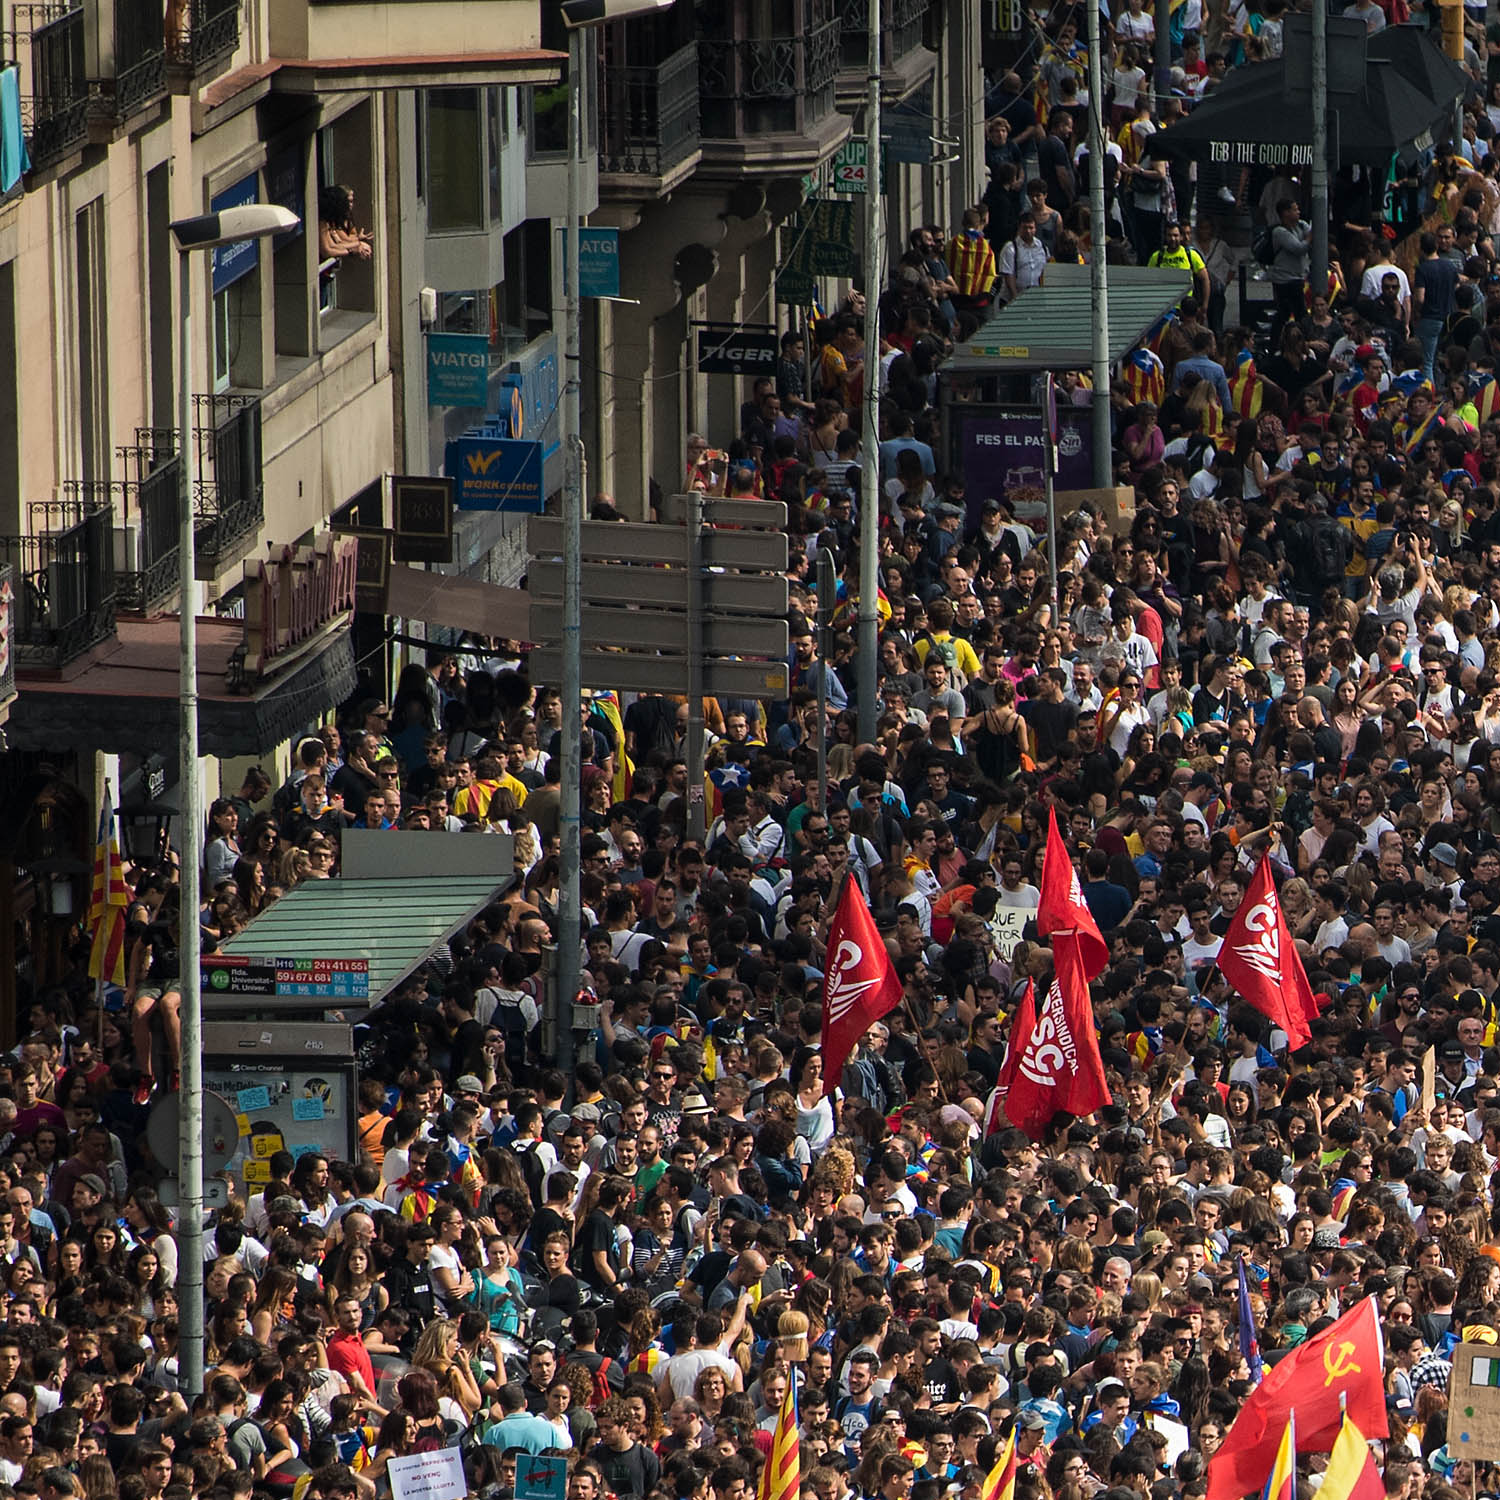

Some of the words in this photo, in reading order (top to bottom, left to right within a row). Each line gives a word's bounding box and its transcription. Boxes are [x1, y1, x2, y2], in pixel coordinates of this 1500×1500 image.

[1210, 141, 1228, 161] TGB
[1236, 142, 1256, 163] THE
[1259, 143, 1288, 165] GOOD
[1292, 145, 1313, 165] BUR
[843, 167, 864, 180] 24
[703, 345, 775, 362] TIGER
[976, 434, 1000, 446] FES
[1005, 435, 1021, 446] EL
[462, 479, 539, 492] WORKcenter
